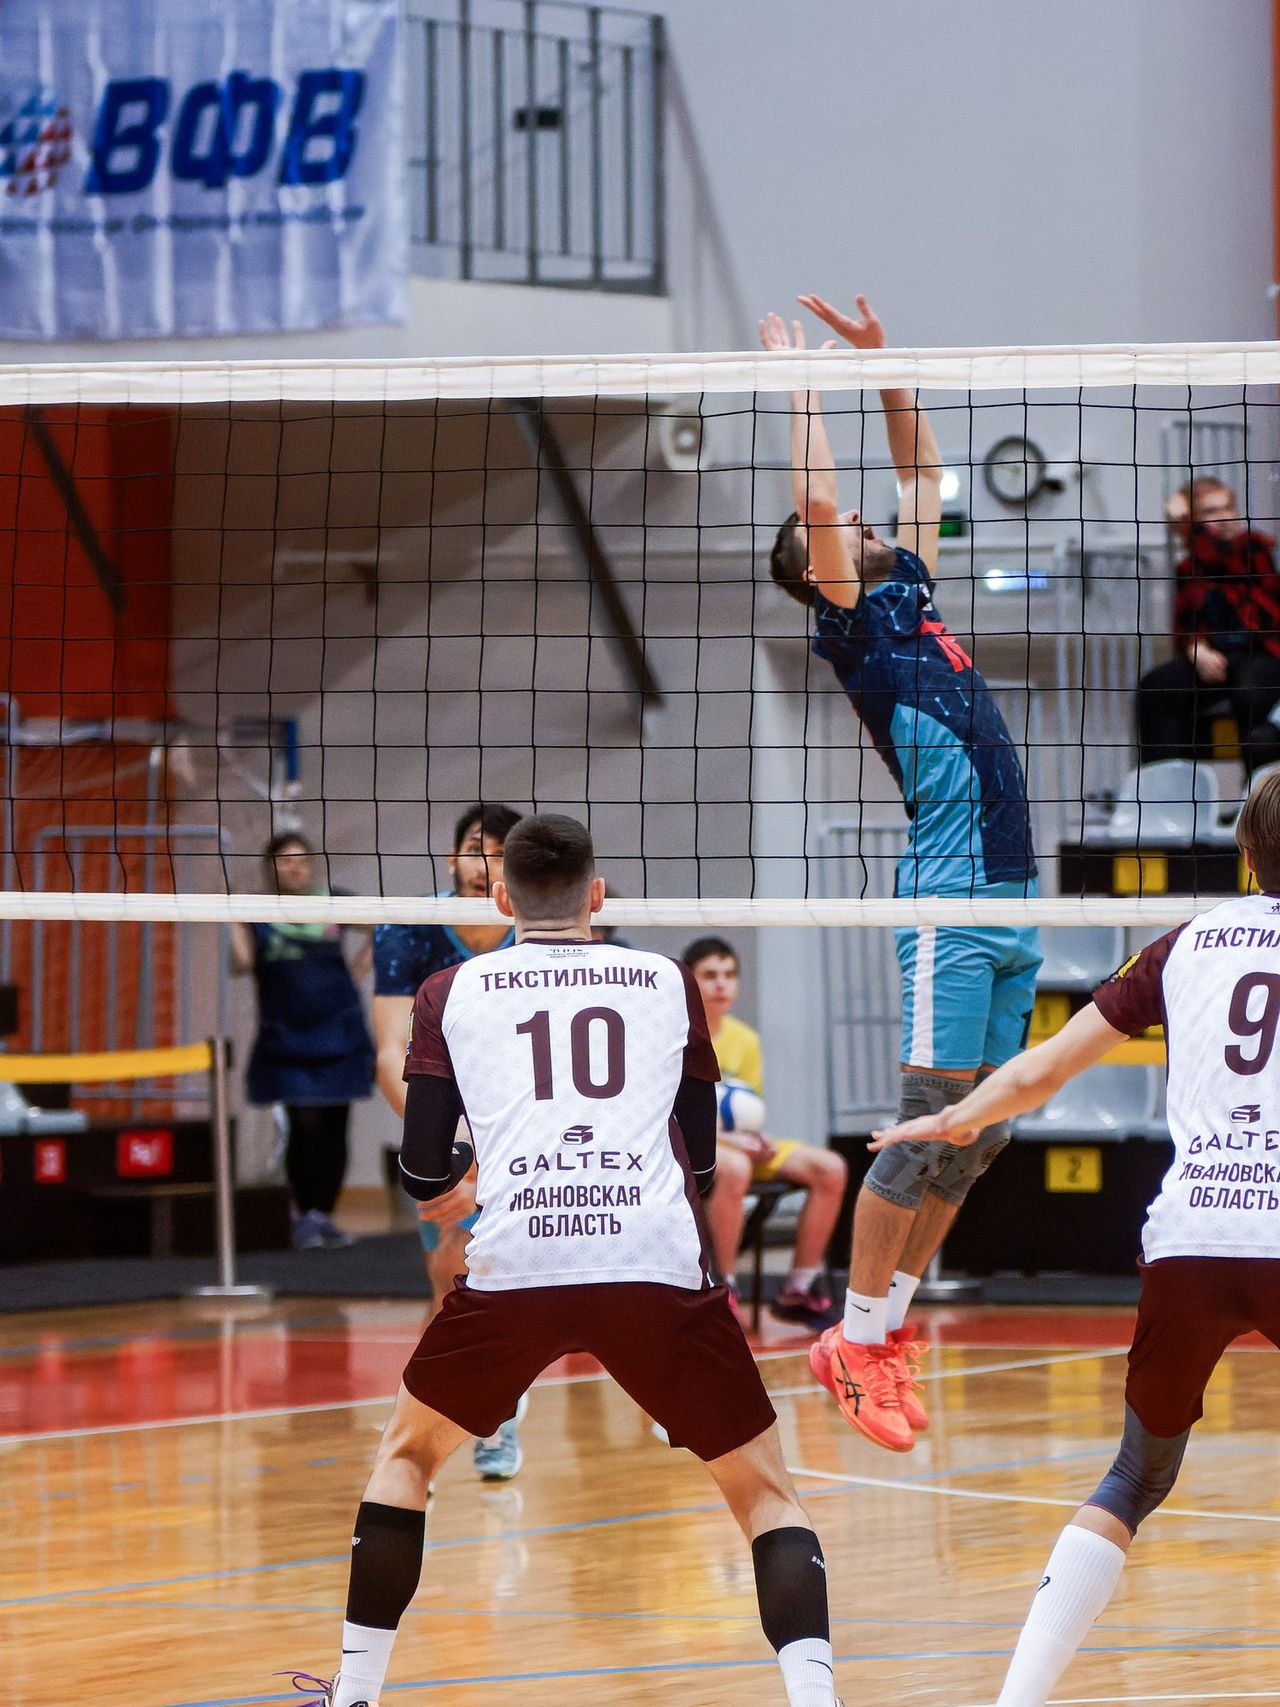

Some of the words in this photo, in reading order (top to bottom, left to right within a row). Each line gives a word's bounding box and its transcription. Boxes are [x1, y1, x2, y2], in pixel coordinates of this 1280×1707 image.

[85, 69, 366, 194] ВФВ
[479, 966, 659, 992] ТЕКСТИЛЬЩИК
[515, 1006, 626, 1101] 10
[508, 1151, 643, 1176] GALTEX
[509, 1184, 641, 1212] ИВАНОВСКАЯ
[1189, 1186, 1279, 1211] ОБЛАСТЬ
[528, 1213, 622, 1239] ОБЛАСТЬ
